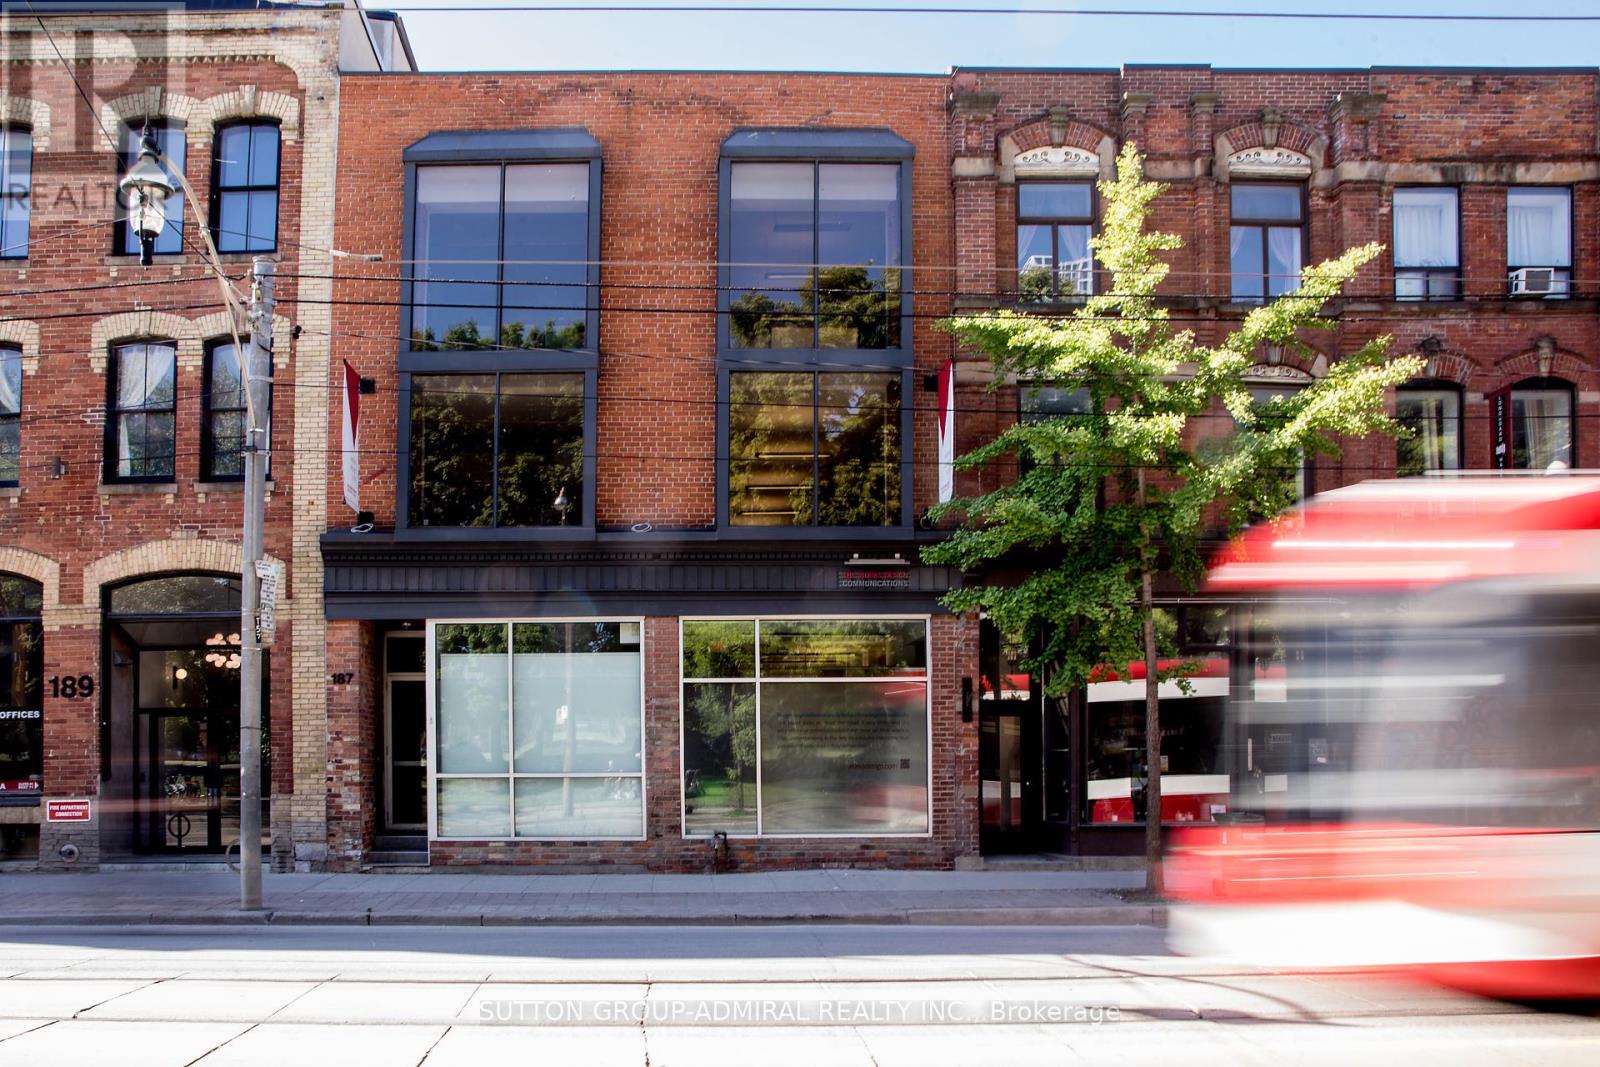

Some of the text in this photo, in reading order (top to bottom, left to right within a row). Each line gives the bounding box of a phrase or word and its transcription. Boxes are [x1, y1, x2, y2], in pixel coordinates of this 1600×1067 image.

[331, 673, 354, 685] 187
[48, 675, 94, 698] 189
[0, 711, 40, 719] OFFICES
